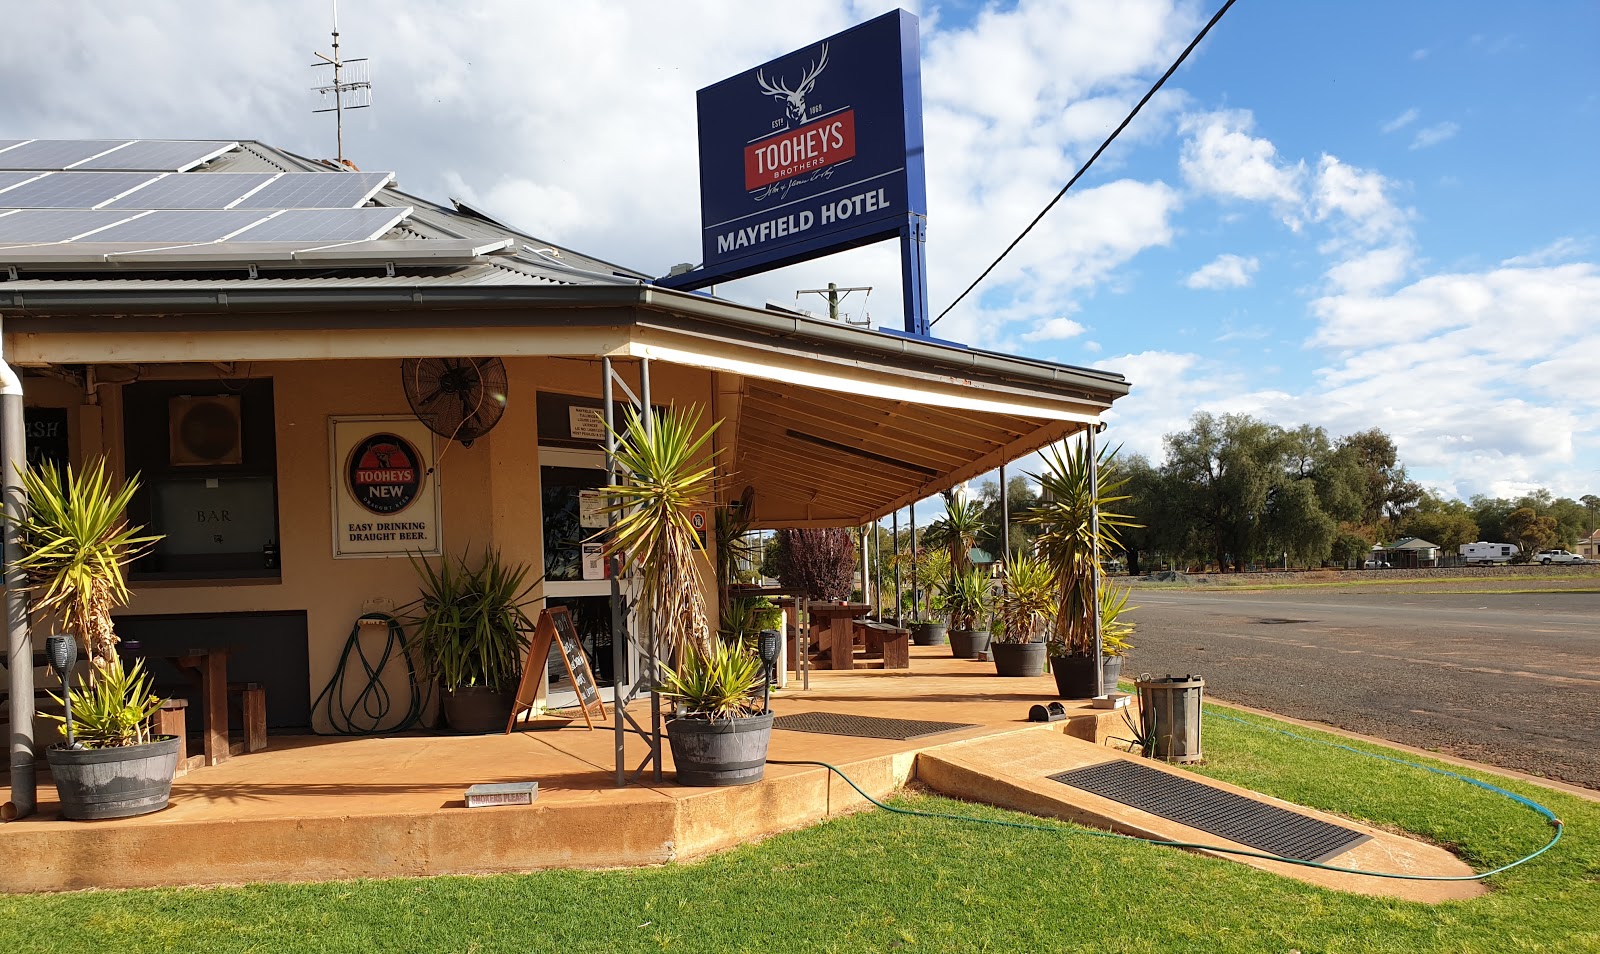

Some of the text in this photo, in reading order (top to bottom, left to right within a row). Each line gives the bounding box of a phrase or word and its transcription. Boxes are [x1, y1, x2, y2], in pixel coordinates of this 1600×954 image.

[809, 104, 823, 115] 1869
[755, 121, 844, 174] TOOHEYS
[774, 156, 825, 179] BROTHERS
[716, 188, 890, 255] MAYFIELD HOTEL
[358, 470, 412, 482] TOOHEYS
[369, 485, 404, 498] NEW
[362, 495, 410, 511] DRAUGHT BEER
[196, 510, 232, 523] BAR
[348, 521, 426, 532] EASY DRINKING
[349, 532, 428, 542] DRAUGHT BEER.
[471, 793, 528, 805] SMOKERS PLEASE
